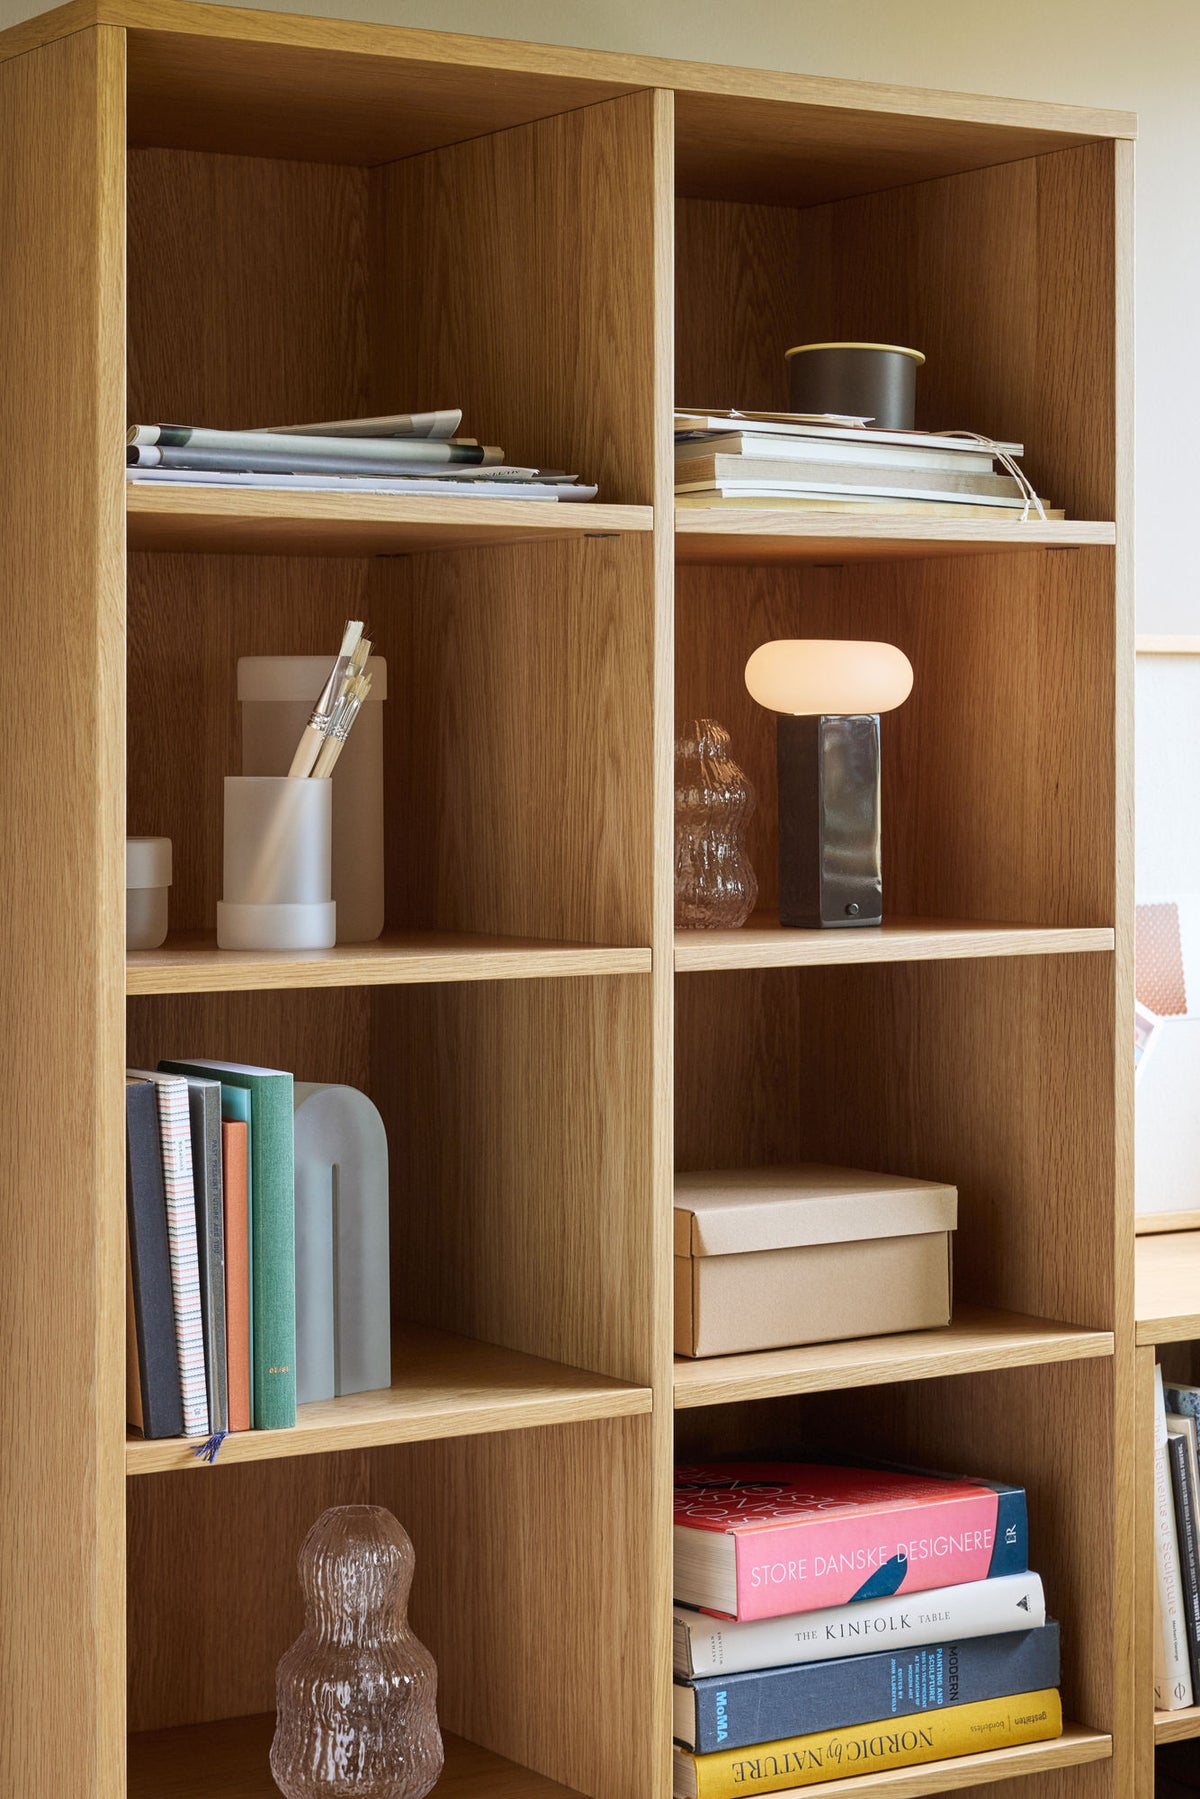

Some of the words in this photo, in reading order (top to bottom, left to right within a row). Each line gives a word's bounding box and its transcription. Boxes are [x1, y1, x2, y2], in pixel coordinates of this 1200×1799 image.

[1155, 1447, 1169, 1517] Elements
[1160, 1522, 1171, 1537] of
[751, 1559, 807, 1588] STORE
[814, 1546, 888, 1577] DANSKE
[896, 1529, 993, 1563] DESIGNERE
[1162, 1541, 1177, 1615] Sculpture
[795, 1630, 818, 1642] THE
[824, 1614, 912, 1640] KINFOLK
[918, 1611, 951, 1625] TABLE
[928, 1654, 936, 1702] SCULPTURE
[936, 1648, 944, 1686] PAINTING
[949, 1646, 960, 1702] MODERN
[716, 1690, 728, 1742] MoMA
[970, 1719, 1005, 1732] borderless
[1014, 1711, 1048, 1727] gestalten
[826, 1738, 844, 1763] by
[847, 1727, 933, 1761] NORDIC
[731, 1749, 824, 1783] NATURE
